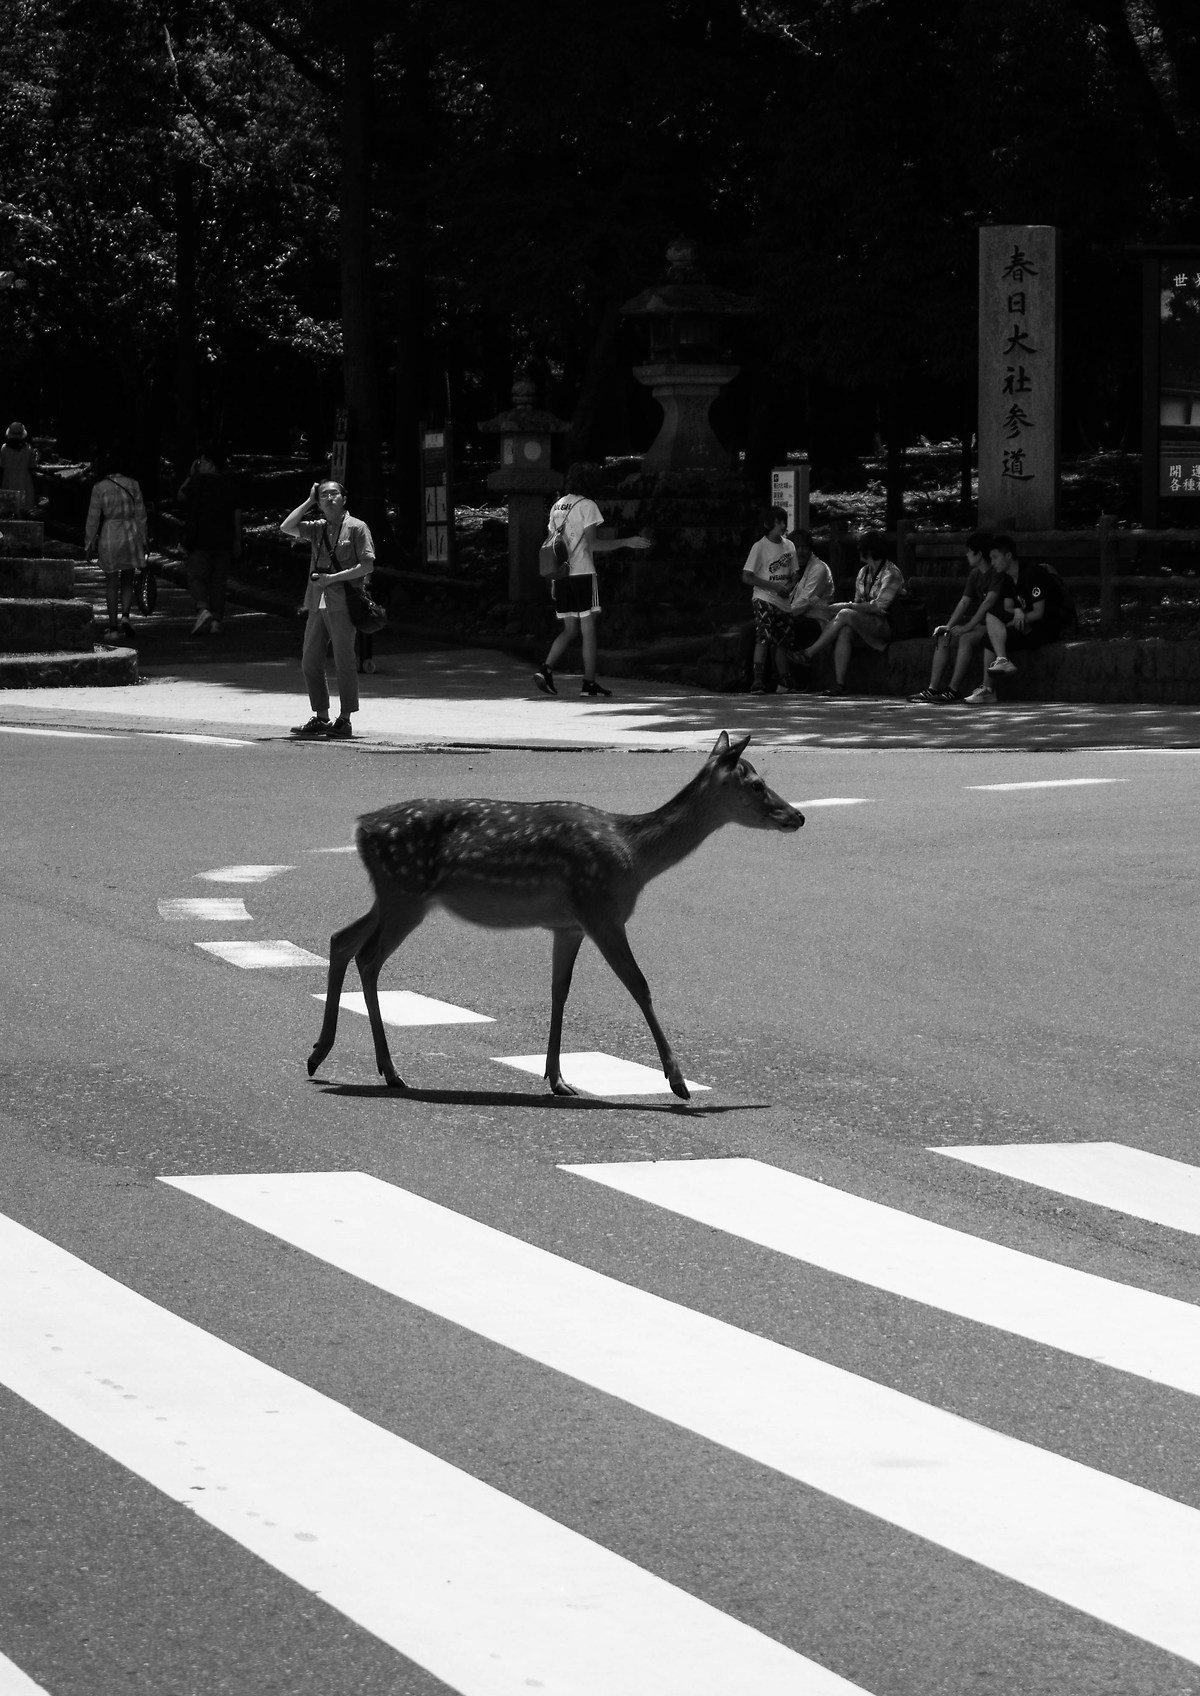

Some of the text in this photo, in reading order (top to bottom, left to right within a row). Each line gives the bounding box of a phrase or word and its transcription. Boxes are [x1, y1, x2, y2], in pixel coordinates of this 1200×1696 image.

[1001, 244, 1039, 481] 春日大社参道
